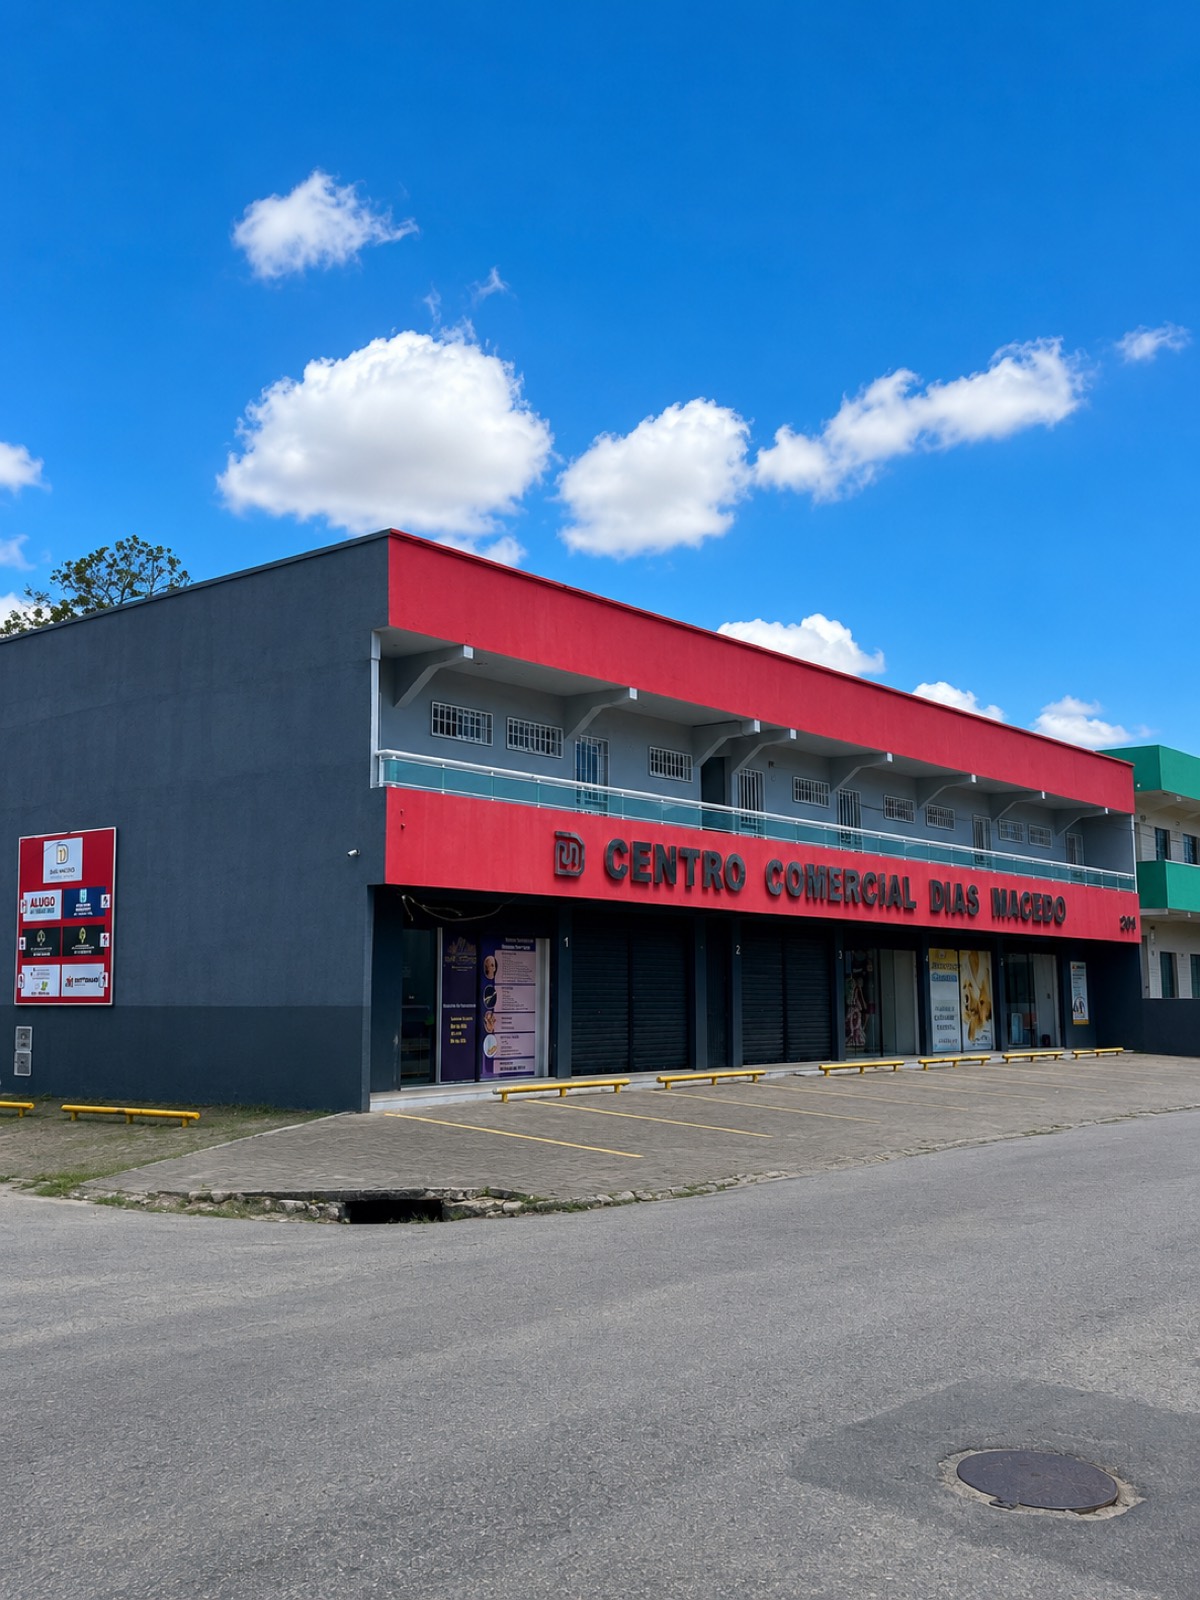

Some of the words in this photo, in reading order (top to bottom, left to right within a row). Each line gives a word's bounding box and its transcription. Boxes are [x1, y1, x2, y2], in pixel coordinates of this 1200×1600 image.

[604, 838, 747, 892] CENTRO
[765, 859, 917, 910] COMERCIAL
[928, 879, 980, 916] DIAS
[990, 887, 1067, 924] MACEDO
[30, 896, 56, 908] ALUGO
[564, 937, 570, 948] 1
[735, 944, 741, 955] 2
